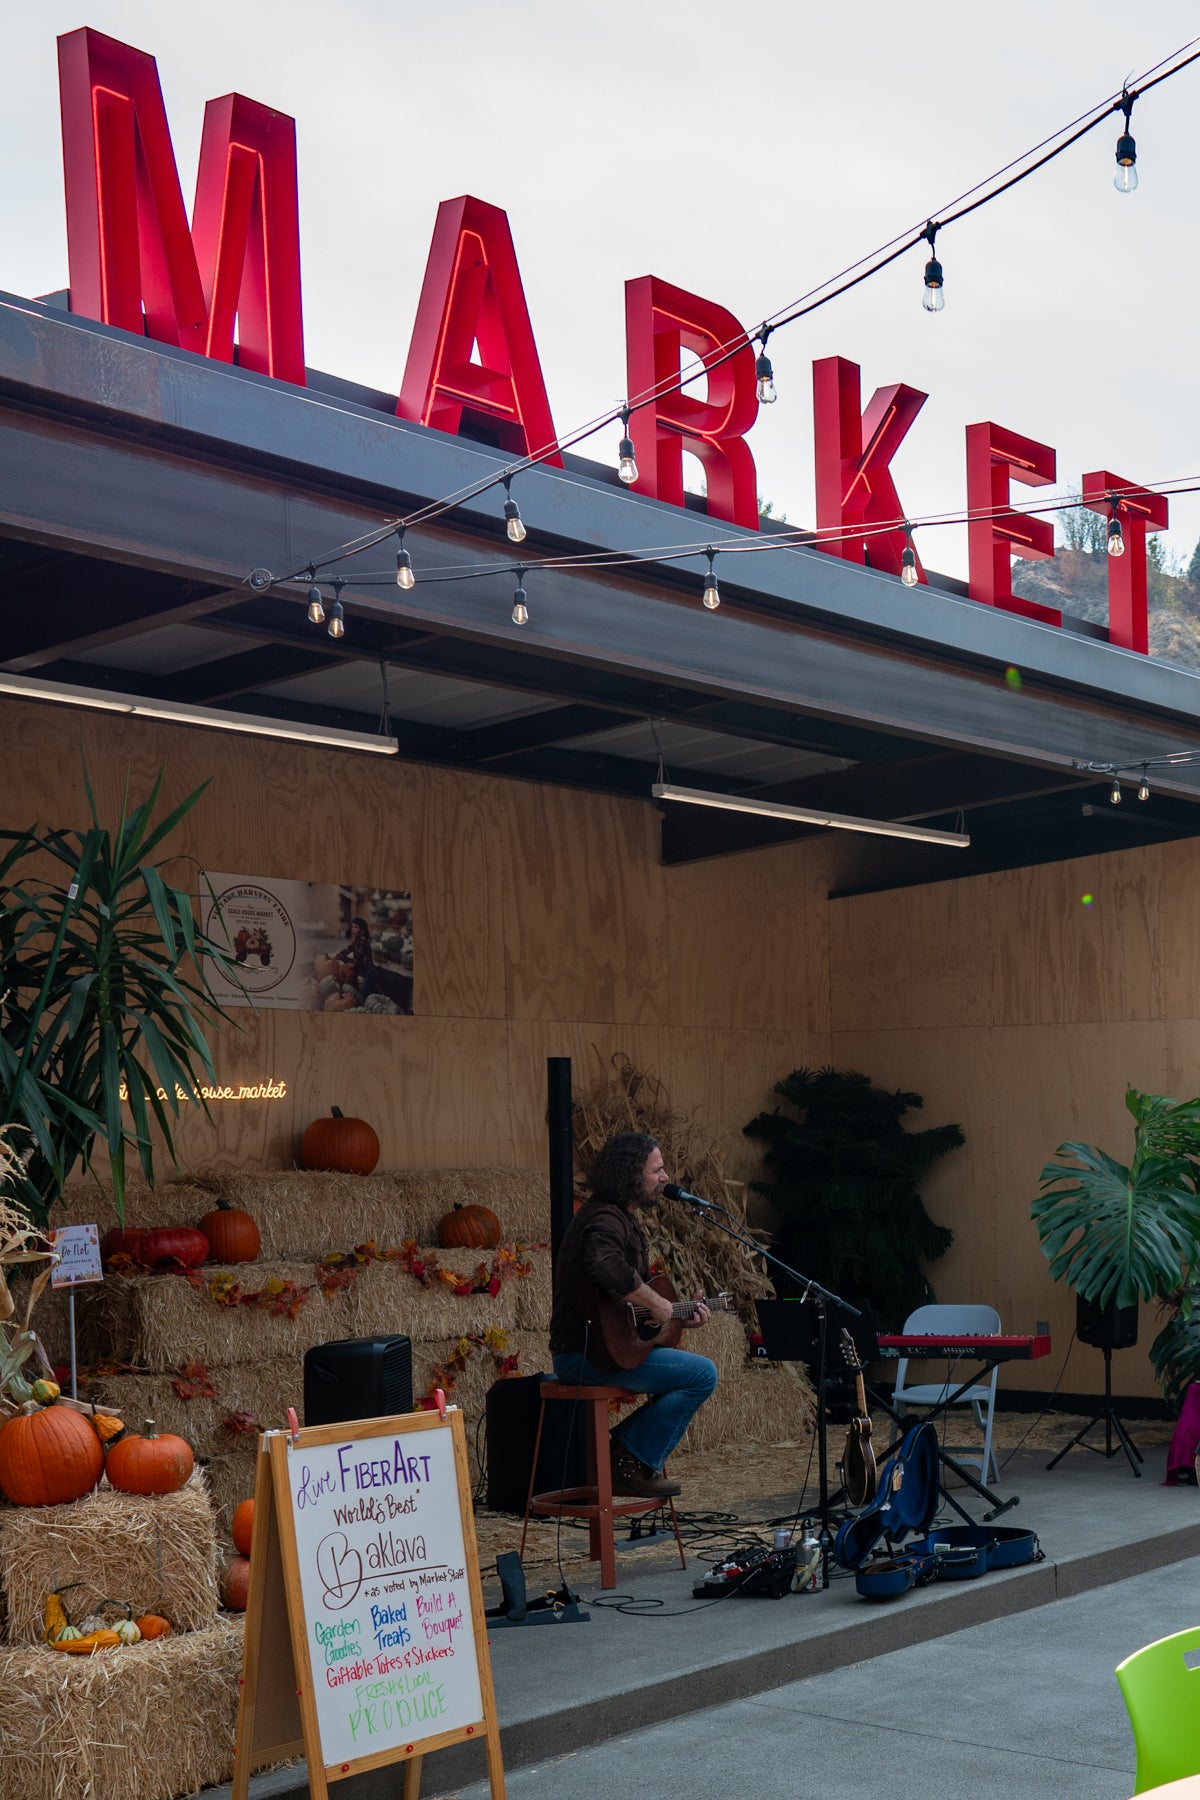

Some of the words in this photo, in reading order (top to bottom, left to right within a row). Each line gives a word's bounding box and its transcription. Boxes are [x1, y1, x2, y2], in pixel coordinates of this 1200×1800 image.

[57, 26, 1169, 655] MARKET
[211, 891, 238, 920] VTAGE
[237, 889, 274, 904] HARVEST
[272, 902, 290, 928] FAIRE
[227, 907, 241, 915] SCALE
[256, 910, 274, 918] MARKET
[61, 1245, 71, 1258] Do
[73, 1243, 90, 1256] Not
[297, 1466, 336, 1510] Live
[333, 1496, 386, 1527] World's
[316, 1531, 427, 1610] Baklava
[383, 1580, 406, 1594] voted
[409, 1578, 420, 1594] by
[419, 1570, 448, 1586] Market
[449, 1567, 465, 1583] Staff
[370, 1601, 408, 1631] Baked
[415, 1592, 443, 1618] Build
[314, 1618, 361, 1645] Garden
[373, 1625, 411, 1651] Treats
[421, 1610, 464, 1643] Bouquet
[324, 1639, 362, 1666] Goodies
[326, 1659, 374, 1688] Giftable
[373, 1653, 403, 1676] Totes
[412, 1646, 455, 1666] Stickers
[355, 1679, 396, 1708] FRESH
[349, 1682, 450, 1742] PRODUCE
